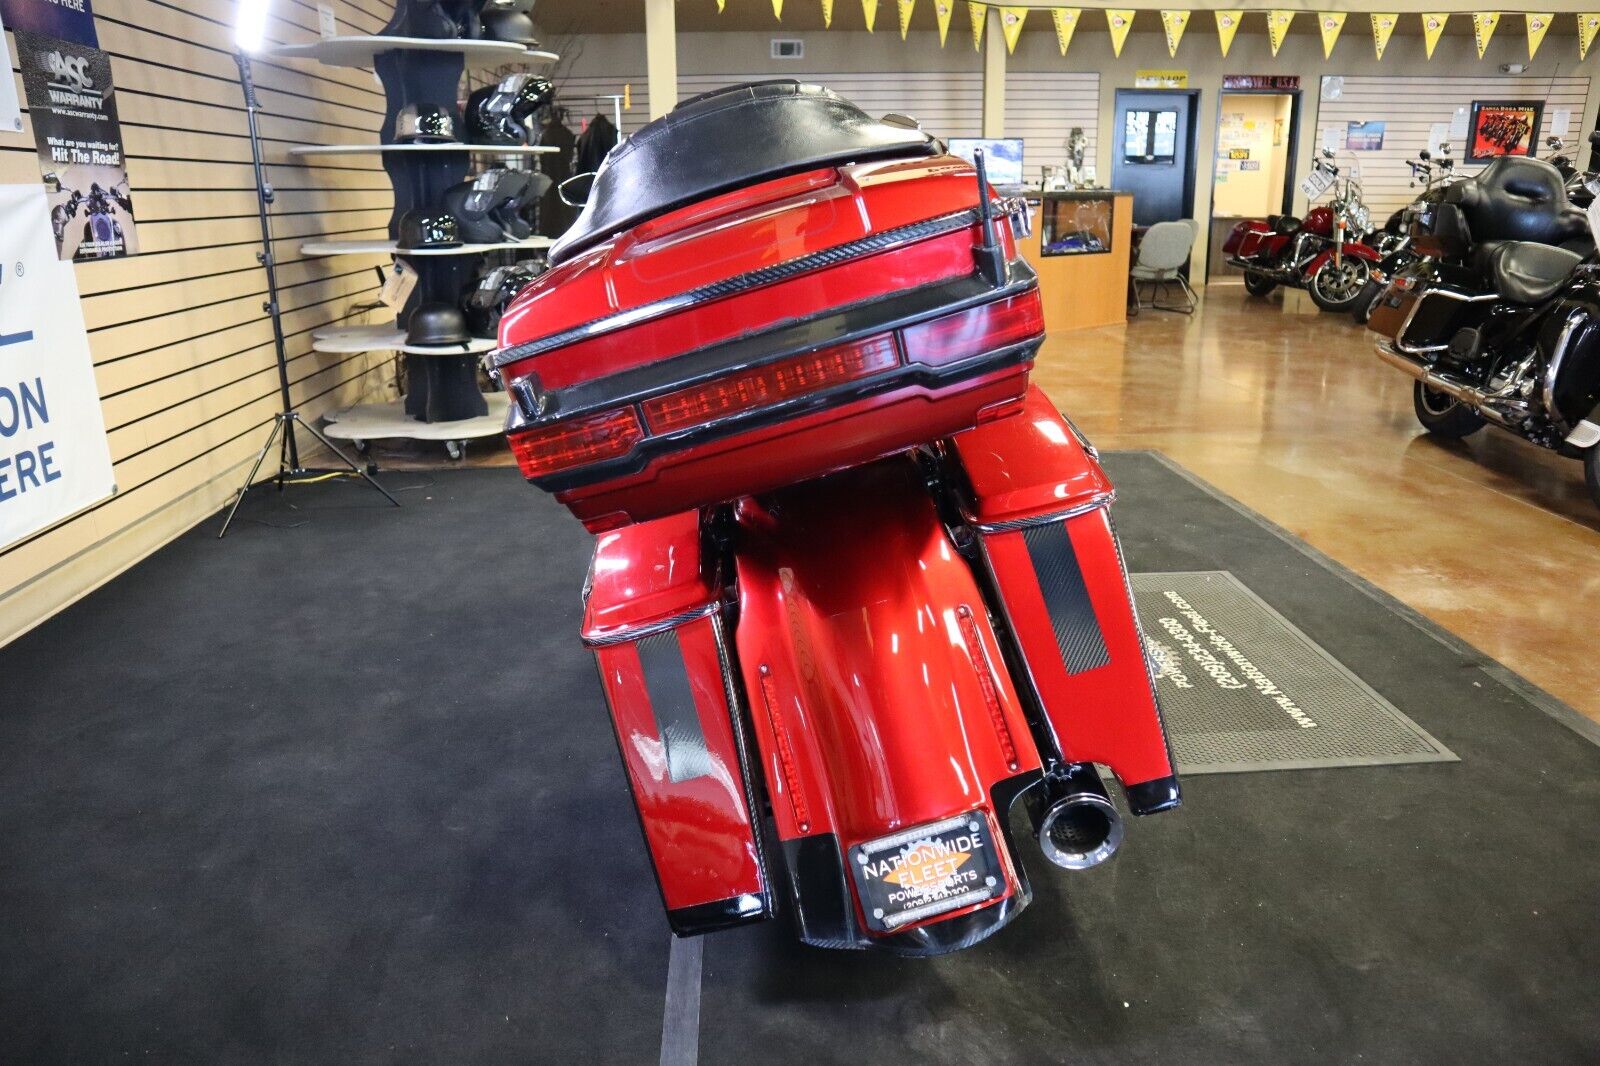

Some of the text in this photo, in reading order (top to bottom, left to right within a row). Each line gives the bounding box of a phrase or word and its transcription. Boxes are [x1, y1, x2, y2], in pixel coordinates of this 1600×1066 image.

[48, 90, 103, 109] WARRANTY
[47, 137, 64, 146] What
[76, 141, 87, 149] you
[87, 141, 108, 151] waiting
[52, 147, 120, 165] Hit The Road!
[863, 833, 983, 880] NATIONWIDE
[898, 858, 958, 885] FLEET
[888, 869, 978, 904] POWERSPORTS
